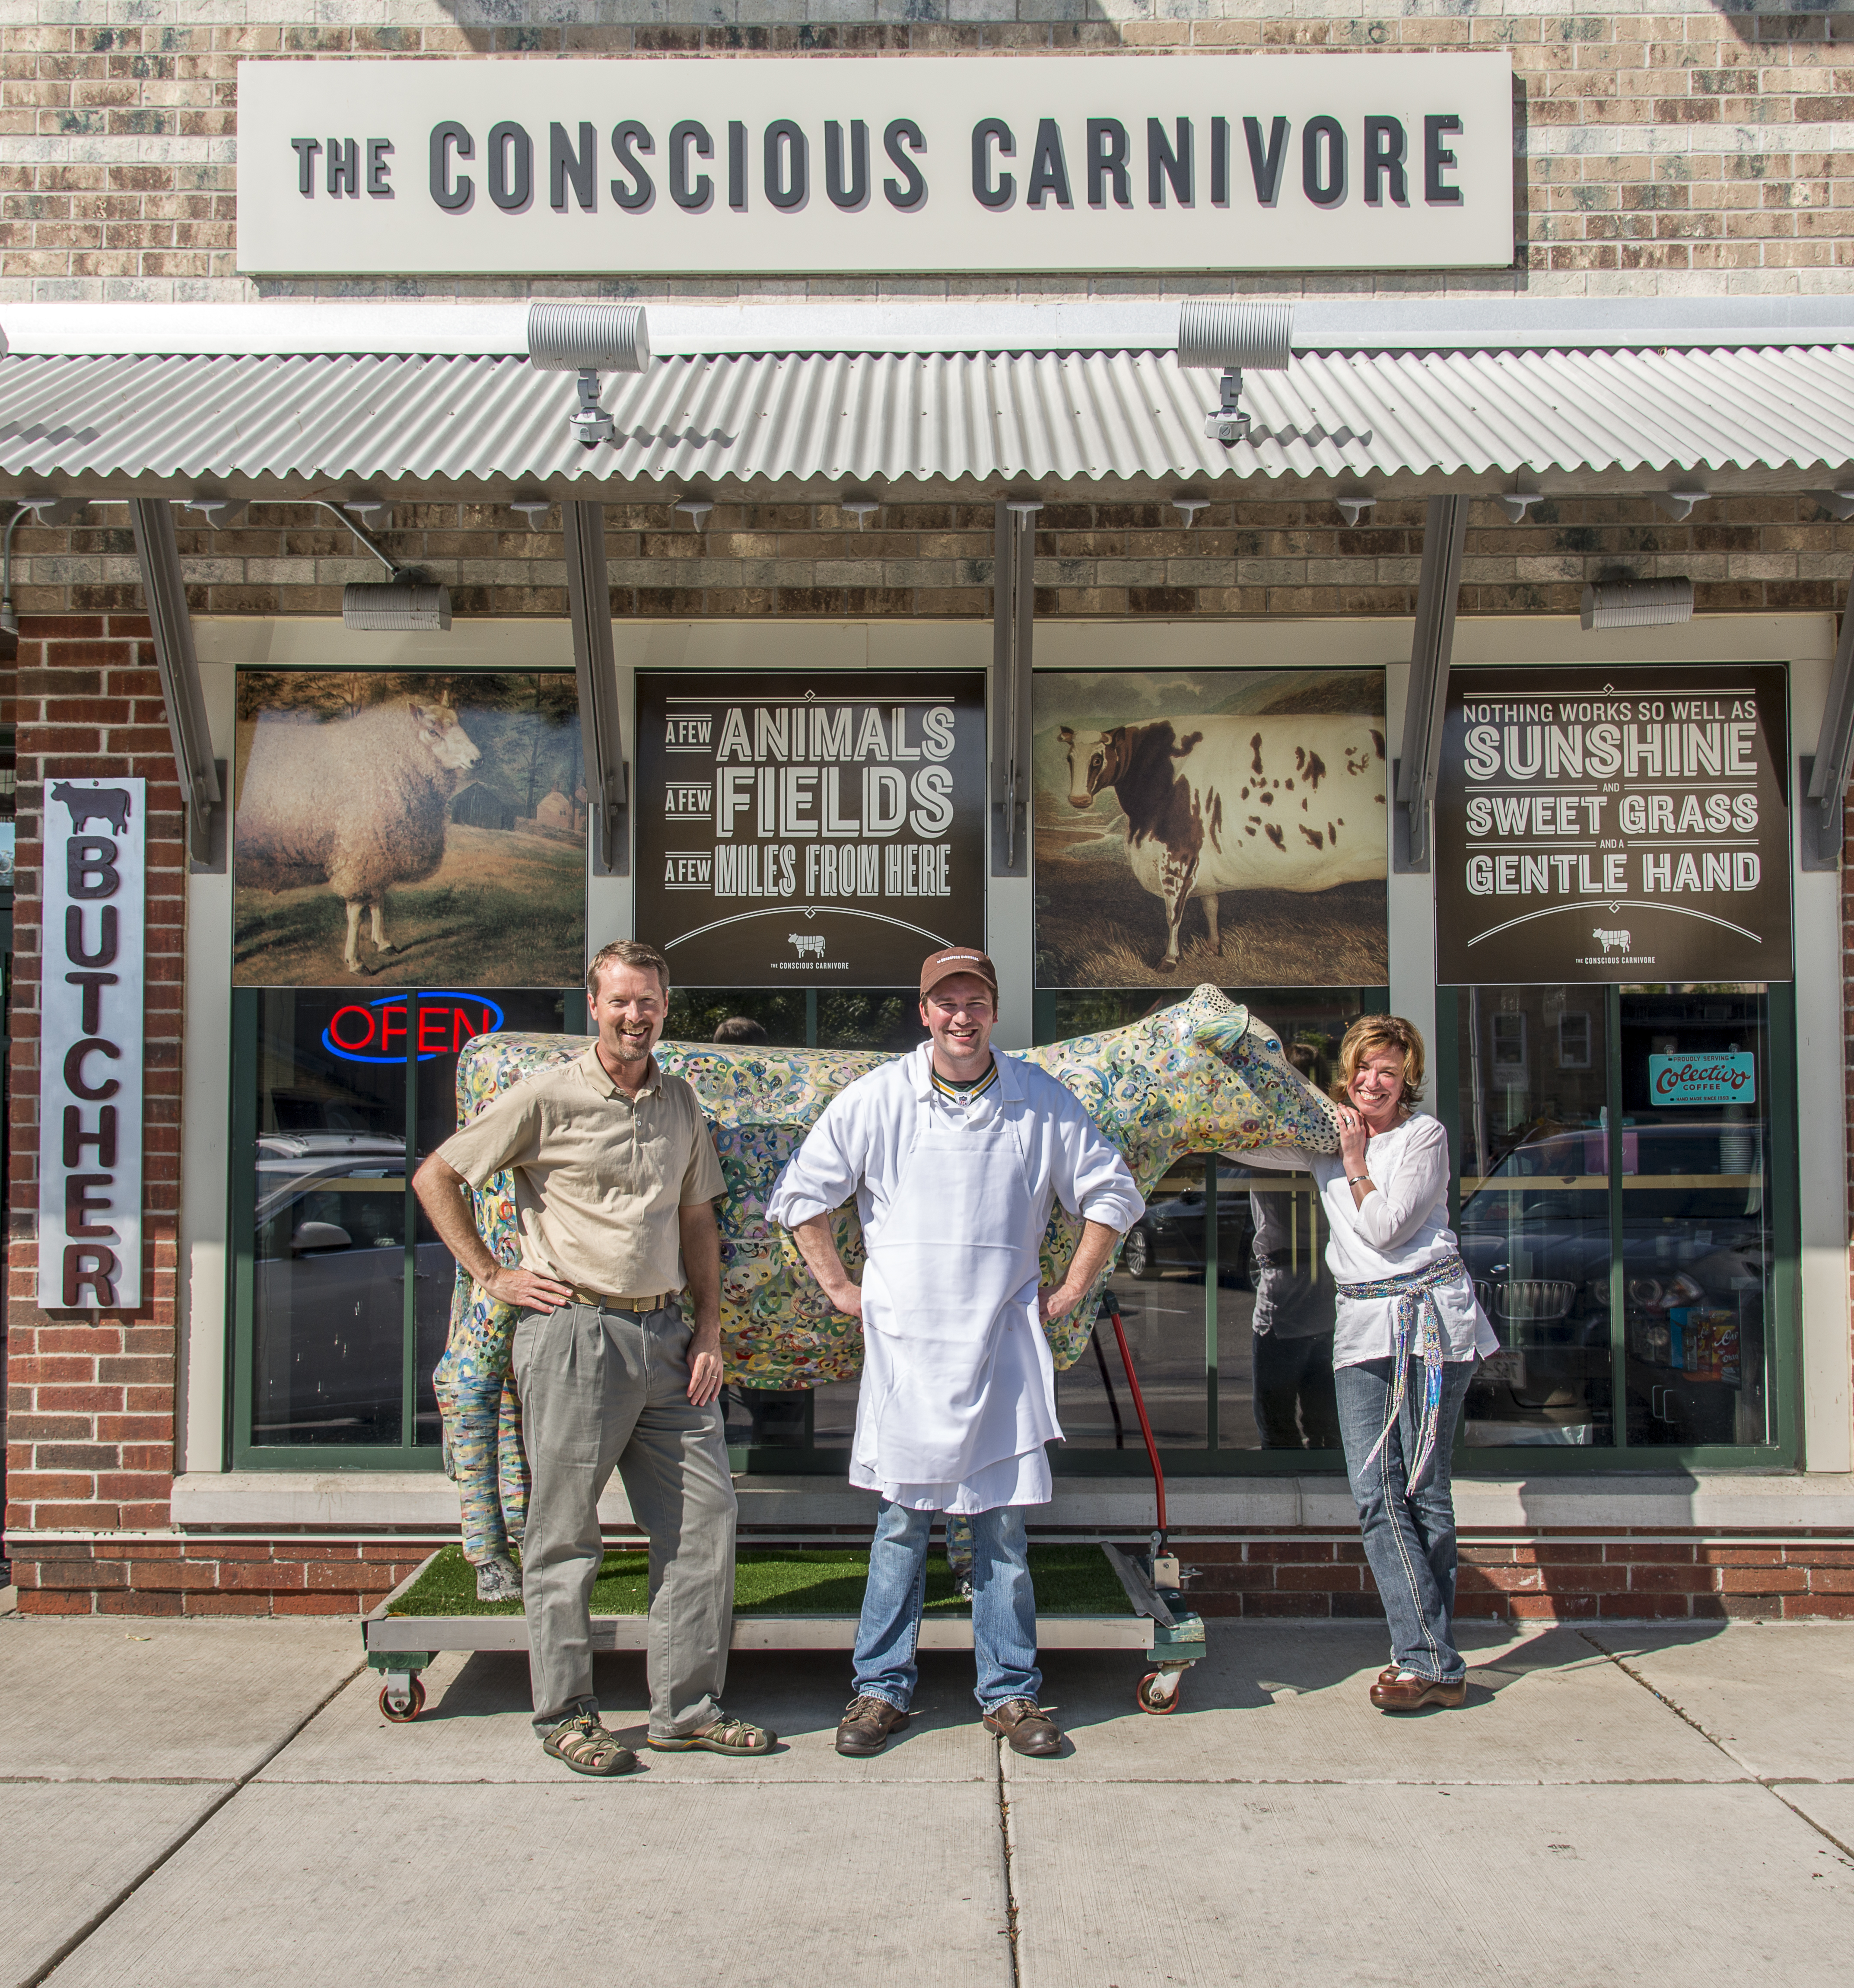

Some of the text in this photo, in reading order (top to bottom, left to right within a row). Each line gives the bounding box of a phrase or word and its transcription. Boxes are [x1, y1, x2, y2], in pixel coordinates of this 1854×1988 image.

[291, 115, 1462, 211] THE CONSCIOUS CARNIVORE
[665, 707, 955, 762] A FEW ANIMALS
[1463, 700, 1756, 723] NOTHING WORKS SO WELL AS
[1464, 722, 1757, 780] SUNSHINE
[665, 765, 954, 838] A FEW FIELDS
[1603, 783, 1619, 792] AND
[1466, 793, 1759, 836] SWEET GRASS
[1600, 839, 1624, 848] AND A
[665, 844, 951, 897] A FEW MILES FROM HERE
[1466, 852, 1760, 895] GENTLE HAND
[331, 1006, 489, 1052] OPEN
[63, 836, 120, 1306] BUTCHER
[1656, 1064, 1751, 1094] Colectivo
